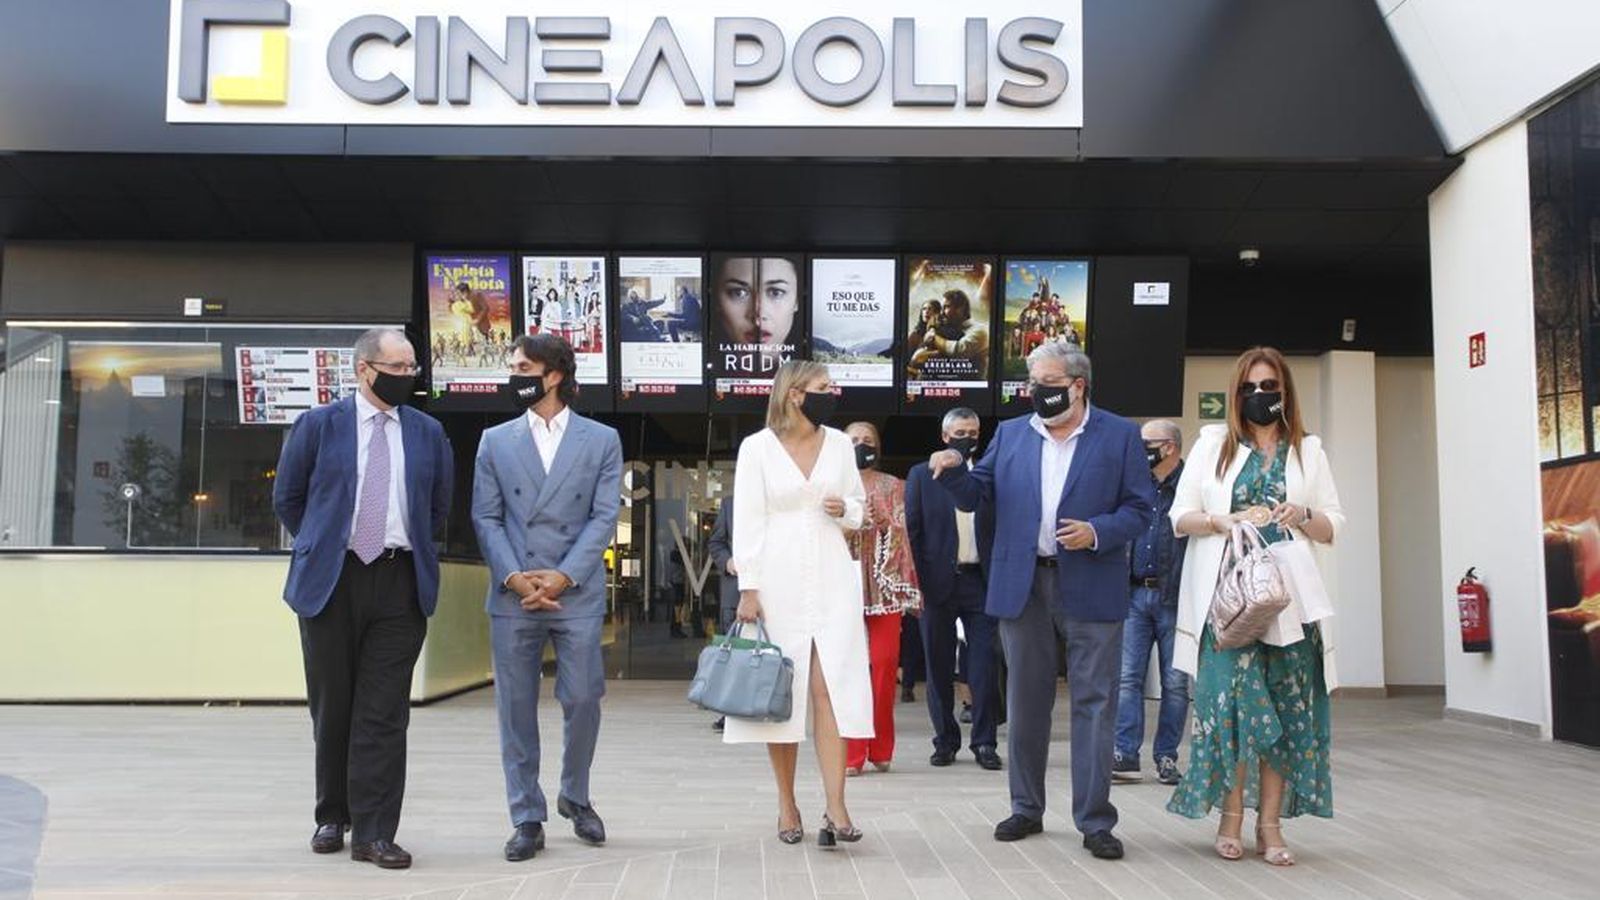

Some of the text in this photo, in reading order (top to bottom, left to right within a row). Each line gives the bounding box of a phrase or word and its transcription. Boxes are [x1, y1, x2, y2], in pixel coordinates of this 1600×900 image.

[326, 16, 1070, 110] CINEAPOLIS
[433, 264, 495, 278] Explota
[832, 292, 875, 302] ESO QUE
[842, 303, 858, 311] ME
[859, 303, 880, 311] DAS
[719, 343, 734, 352] LA
[725, 354, 791, 372] ROOM
